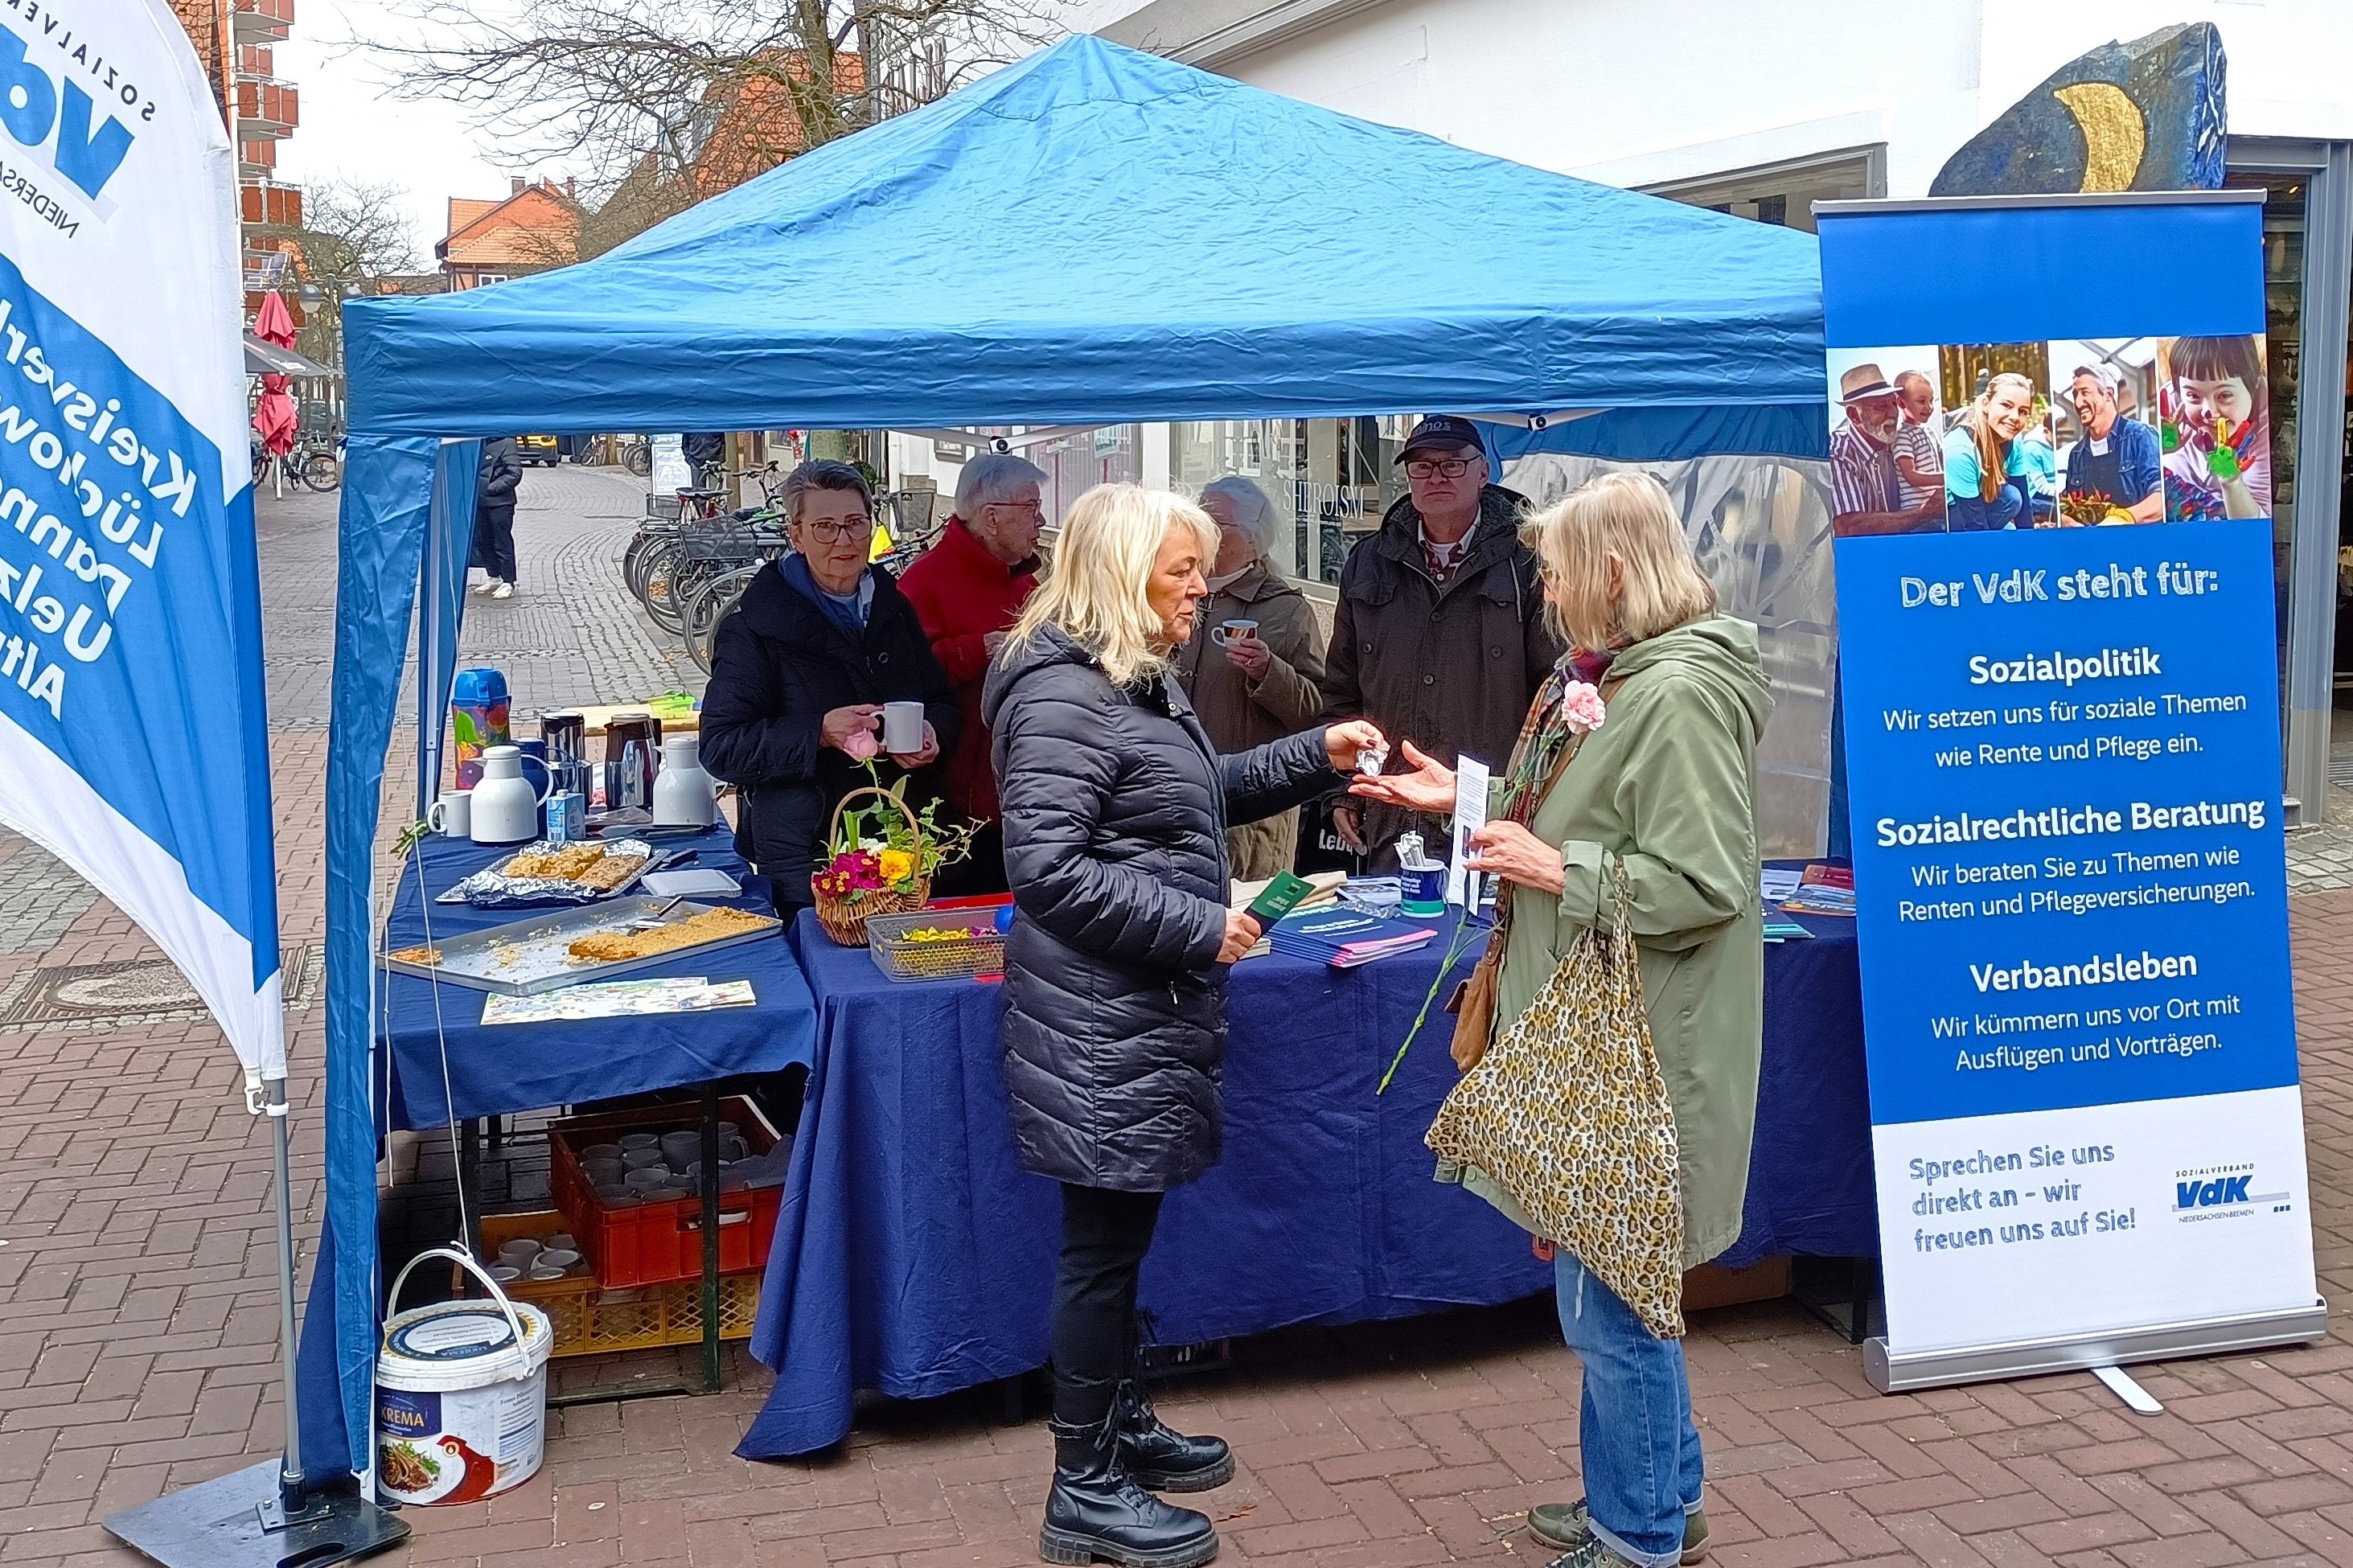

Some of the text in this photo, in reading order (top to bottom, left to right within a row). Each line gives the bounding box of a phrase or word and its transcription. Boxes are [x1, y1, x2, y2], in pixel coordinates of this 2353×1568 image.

[1283, 480, 1365, 521] SHEROISM
[1901, 562, 2217, 607] Der VdK steht für:
[1970, 647, 2161, 686] Sozialpolitik
[1883, 694, 2245, 730] Wir setzen uns für soziale Themen
[1936, 733, 2203, 766] wie Rente und Pflege ein.
[1877, 801, 2265, 846] Sozialrechtliche Beratung
[1912, 846, 2239, 886] Wir beraten Sie zu Themen wie
[1900, 882, 2254, 921] Renten und Pflegeversicherungen.
[1969, 951, 2196, 991] Verbandsleben
[1932, 995, 2240, 1038] Wir kümmern uns vor Ort mit
[1957, 1033, 2221, 1070] Ausflügen und Vorträgen.
[1909, 1145, 2114, 1186] Sprechen Sie uns
[2175, 1163, 2255, 1178] SOZIALVERBAND
[1912, 1188, 1982, 1216] direkt
[1990, 1189, 2018, 1208] an
[2043, 1179, 2081, 1202] wir
[2176, 1174, 2253, 1209] VdK
[1915, 1208, 2135, 1252] freuen uns auf Sie!
